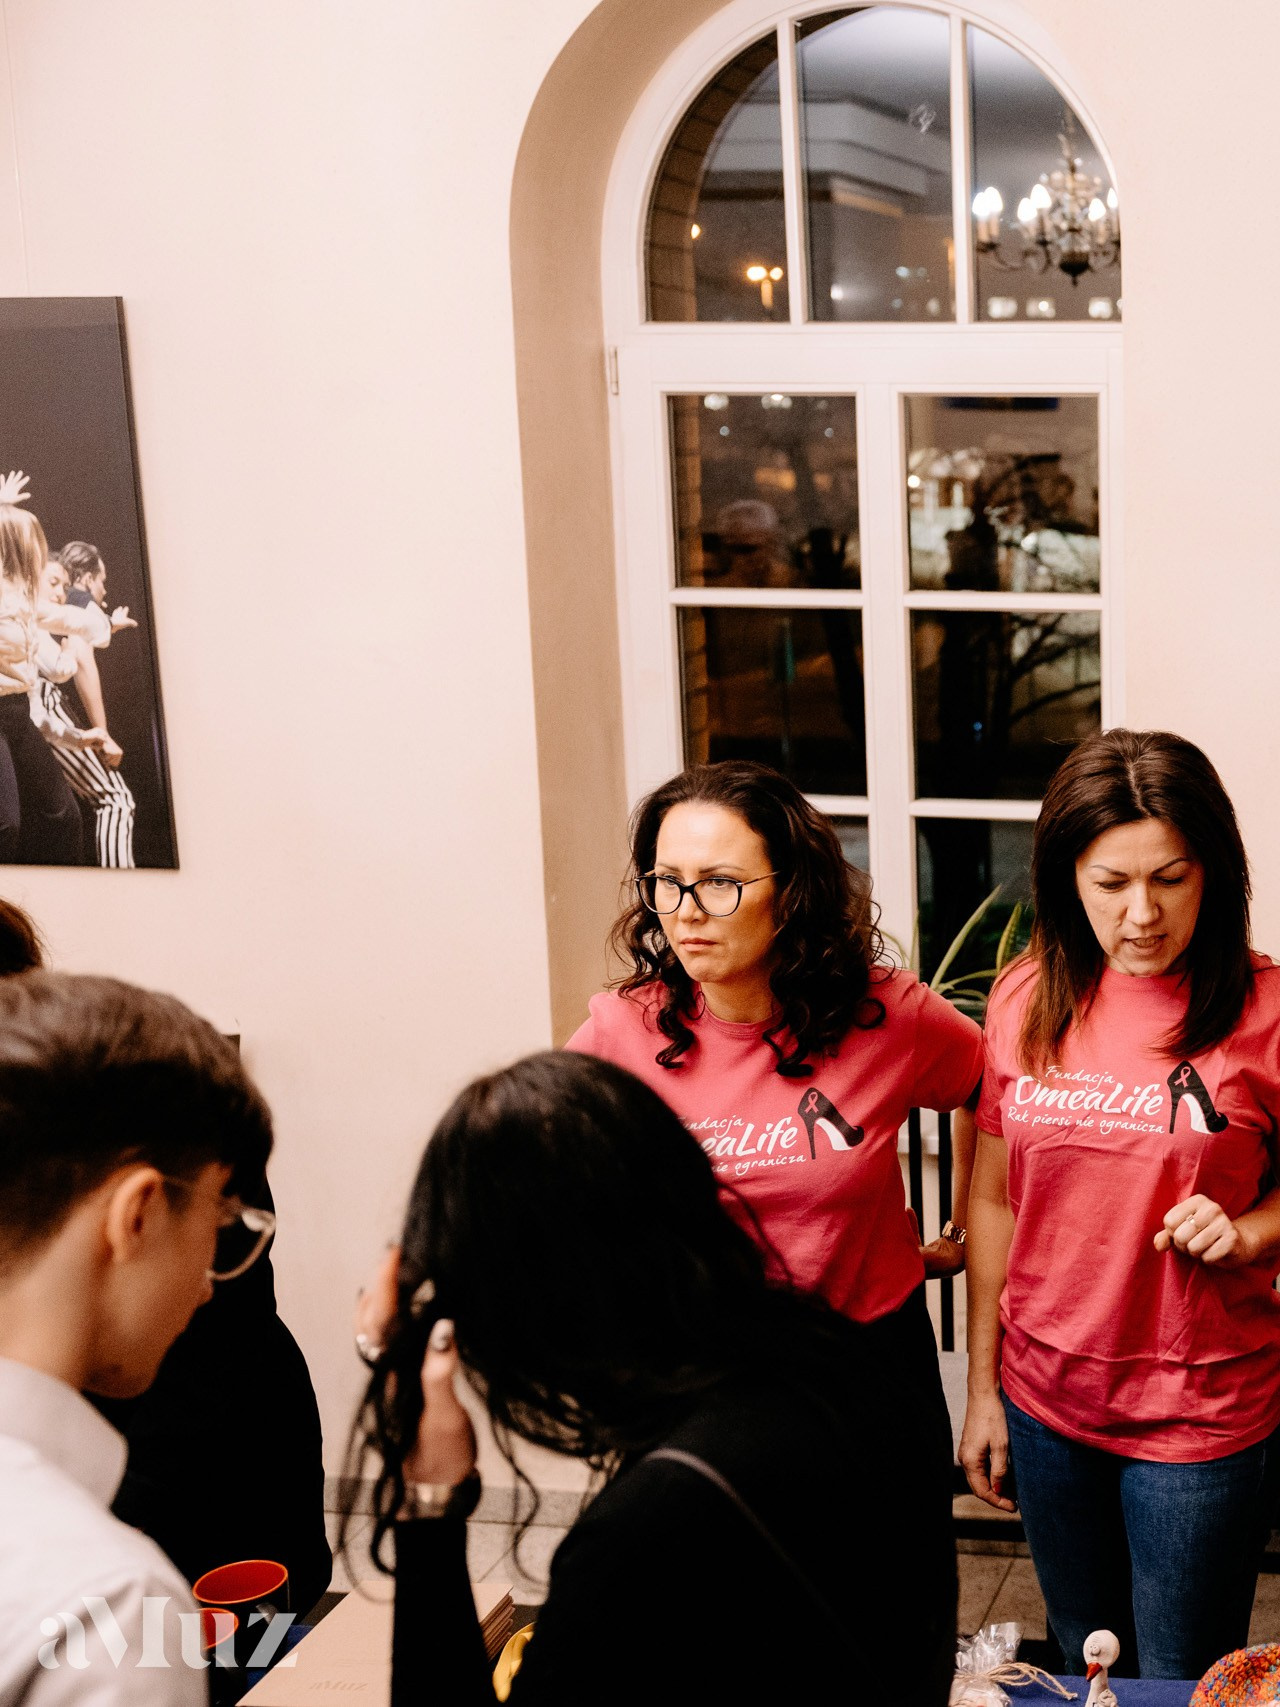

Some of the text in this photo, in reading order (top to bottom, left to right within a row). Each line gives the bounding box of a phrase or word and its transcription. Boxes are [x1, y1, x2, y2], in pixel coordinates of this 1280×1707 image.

[1045, 1065, 1116, 1092] Fundacja
[1015, 1075, 1164, 1118] OmeaLife
[1007, 1106, 1165, 1135] Rak piersi nie ogranicza
[701, 1117, 798, 1157] eaLife
[734, 1154, 807, 1176] ogranicza
